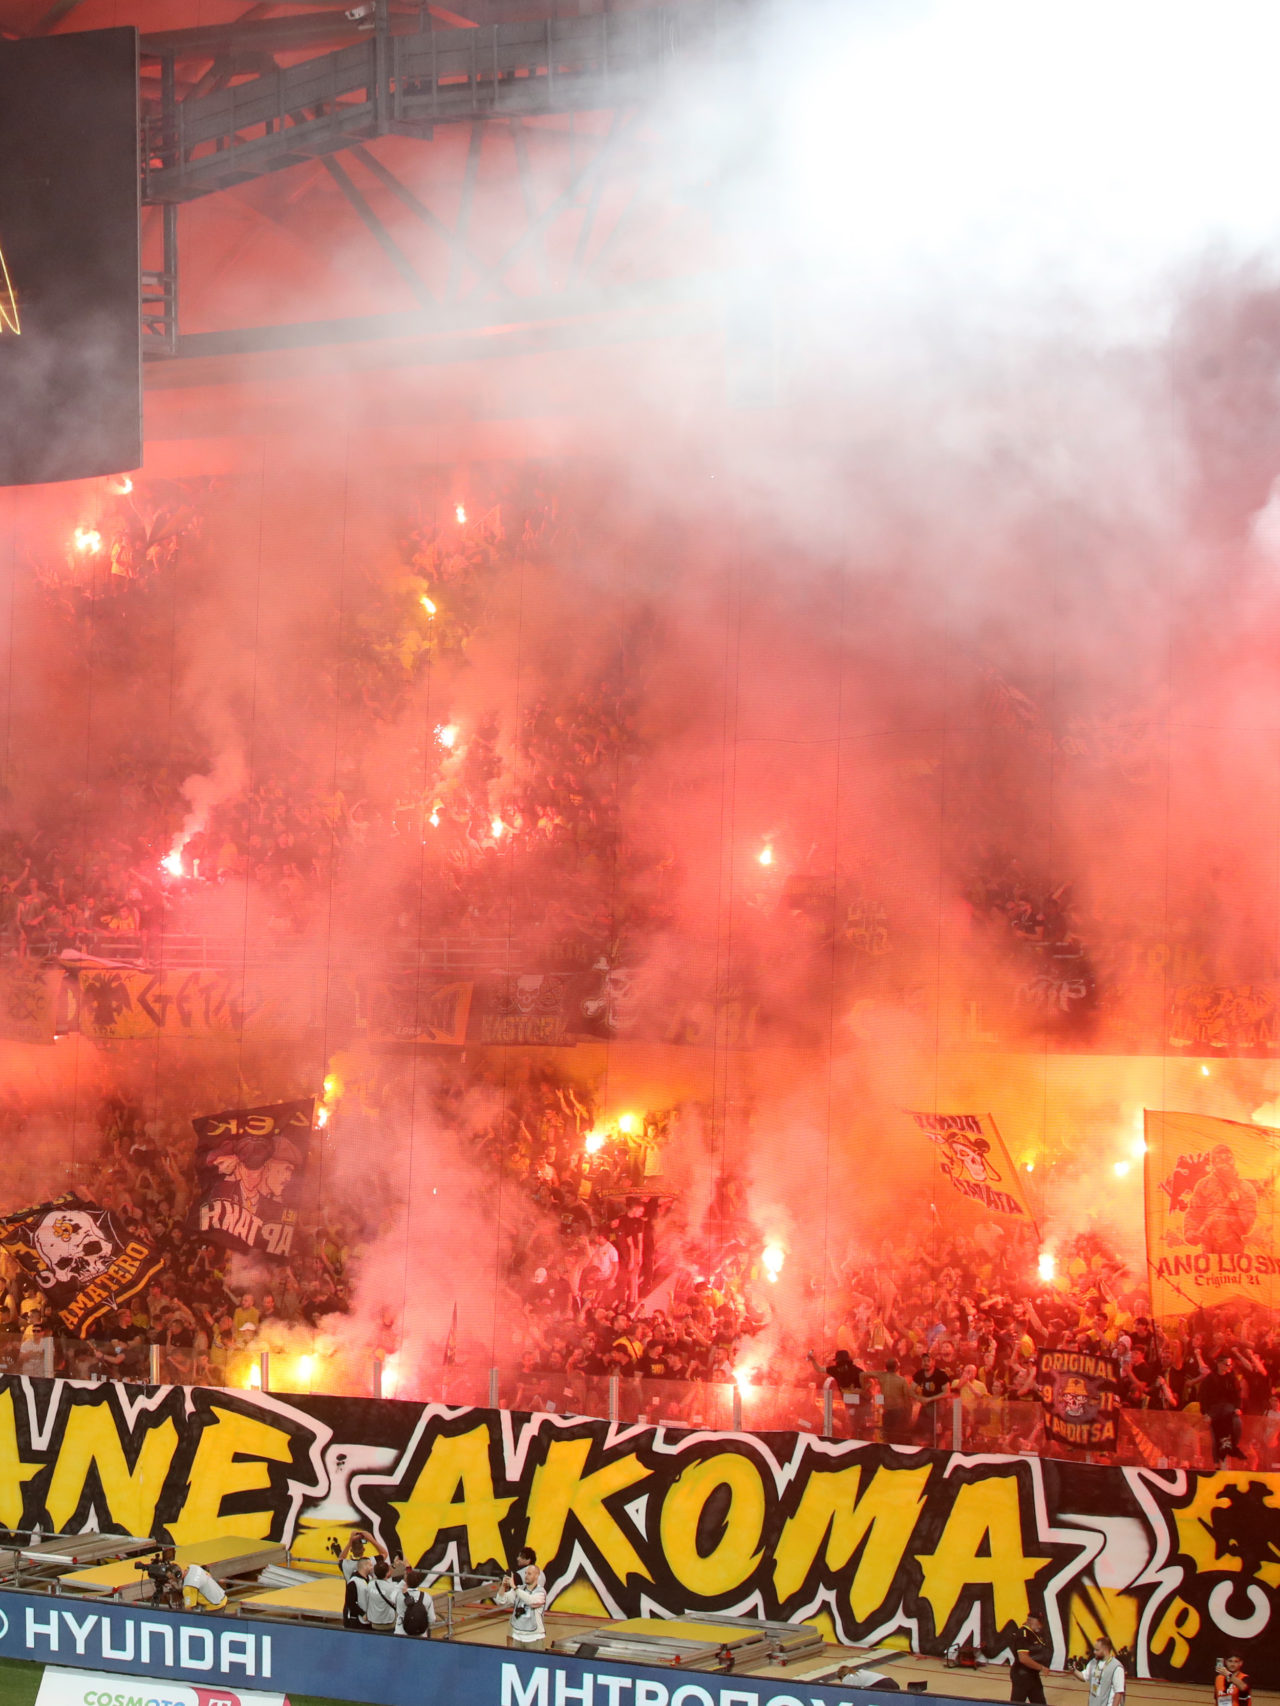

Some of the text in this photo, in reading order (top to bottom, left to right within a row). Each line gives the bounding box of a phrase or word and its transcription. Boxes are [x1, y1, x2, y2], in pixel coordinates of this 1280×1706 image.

[58, 1241, 150, 1330] AMATERO
[1041, 1352, 1118, 1384] ORIGINAL
[389, 1423, 1053, 1638] ΑΚΟΜΑ
[25, 1605, 273, 1678] HYUNDAI
